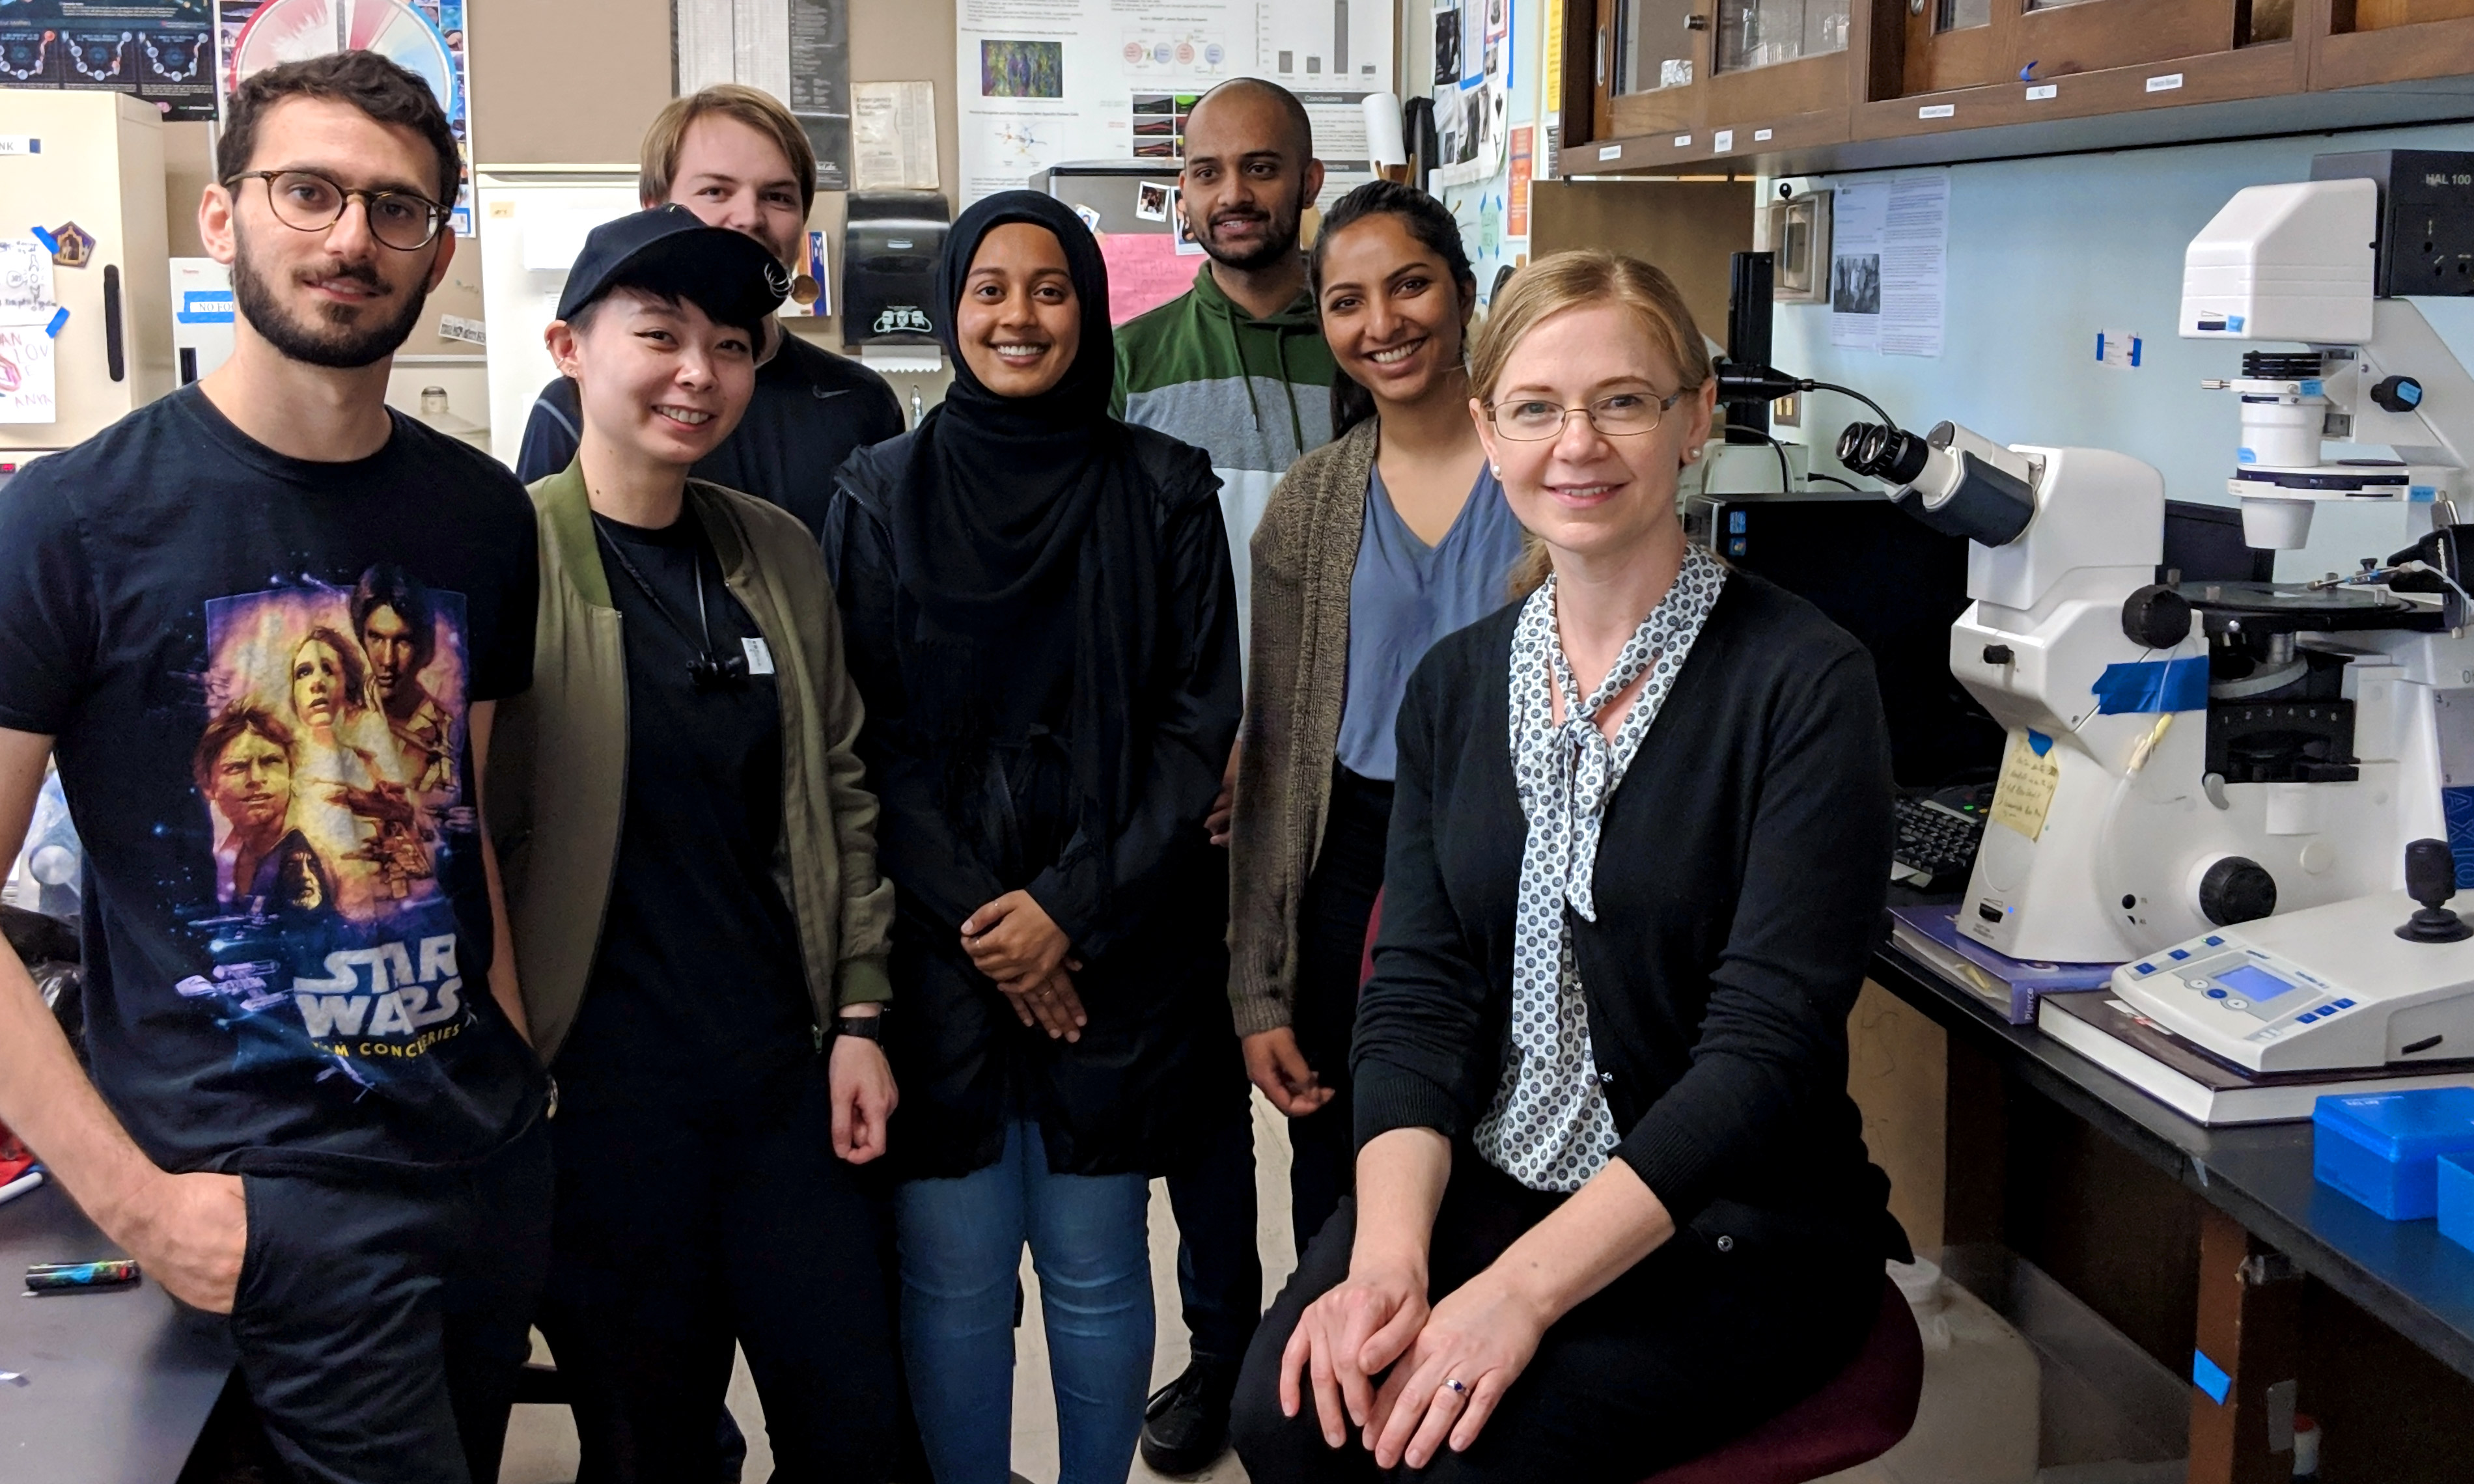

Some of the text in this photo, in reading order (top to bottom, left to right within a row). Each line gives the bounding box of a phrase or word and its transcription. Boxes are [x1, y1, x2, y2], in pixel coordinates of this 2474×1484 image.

[2426, 174, 2471, 185] HAL 100
[199, 303, 234, 312] NO FO
[293, 933, 458, 993] STAR
[294, 976, 462, 1037] WARS
[2025, 987, 2034, 1020] Pierce
